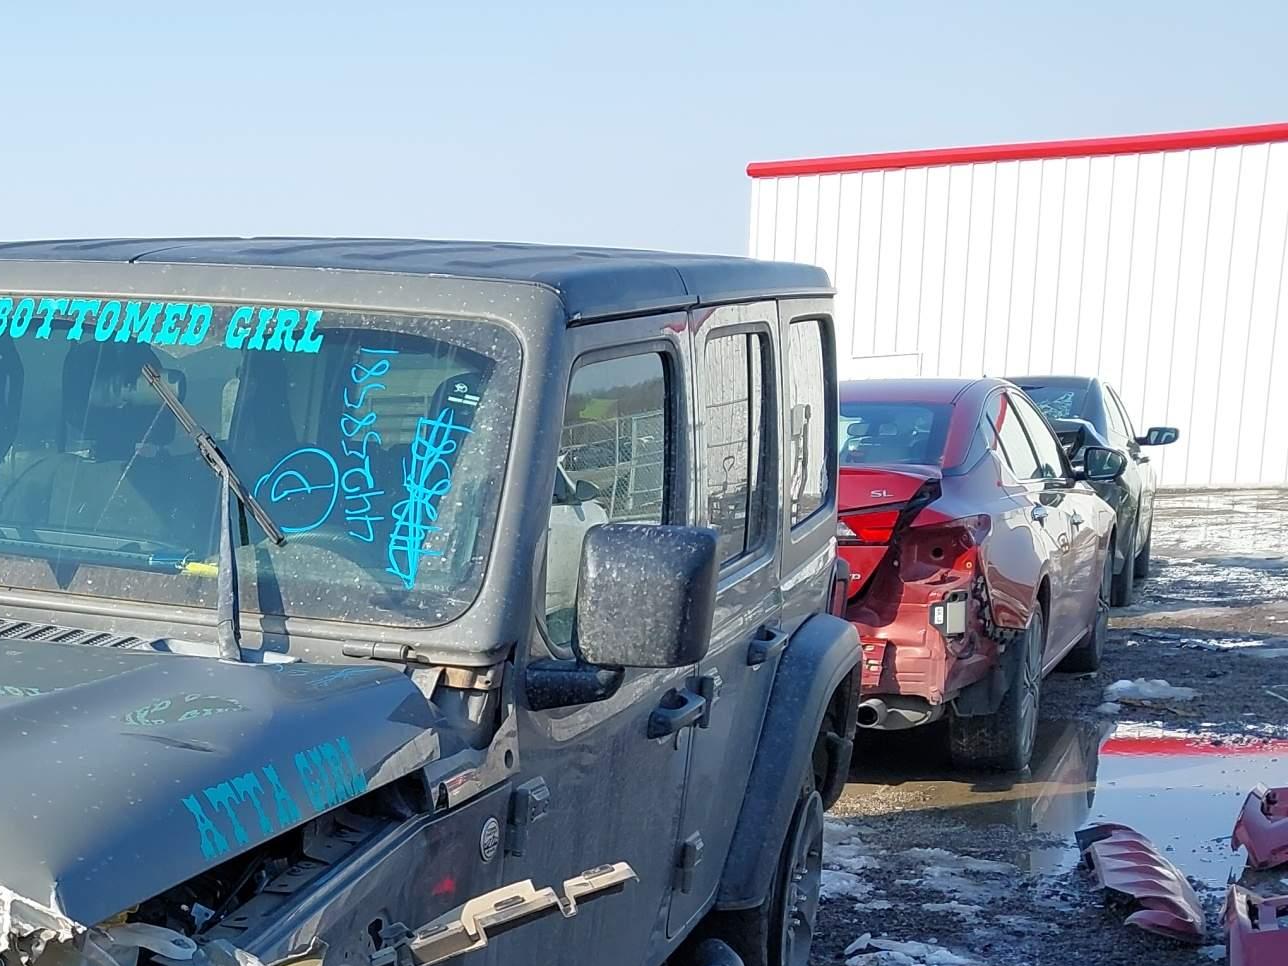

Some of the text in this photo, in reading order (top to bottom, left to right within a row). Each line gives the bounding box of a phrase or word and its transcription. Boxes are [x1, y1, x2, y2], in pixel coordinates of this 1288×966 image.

[223, 303, 326, 355] GIRL
[340, 347, 401, 543] 44258581
[869, 489, 895, 498] SL
[181, 736, 369, 862] ATTA GIRL
